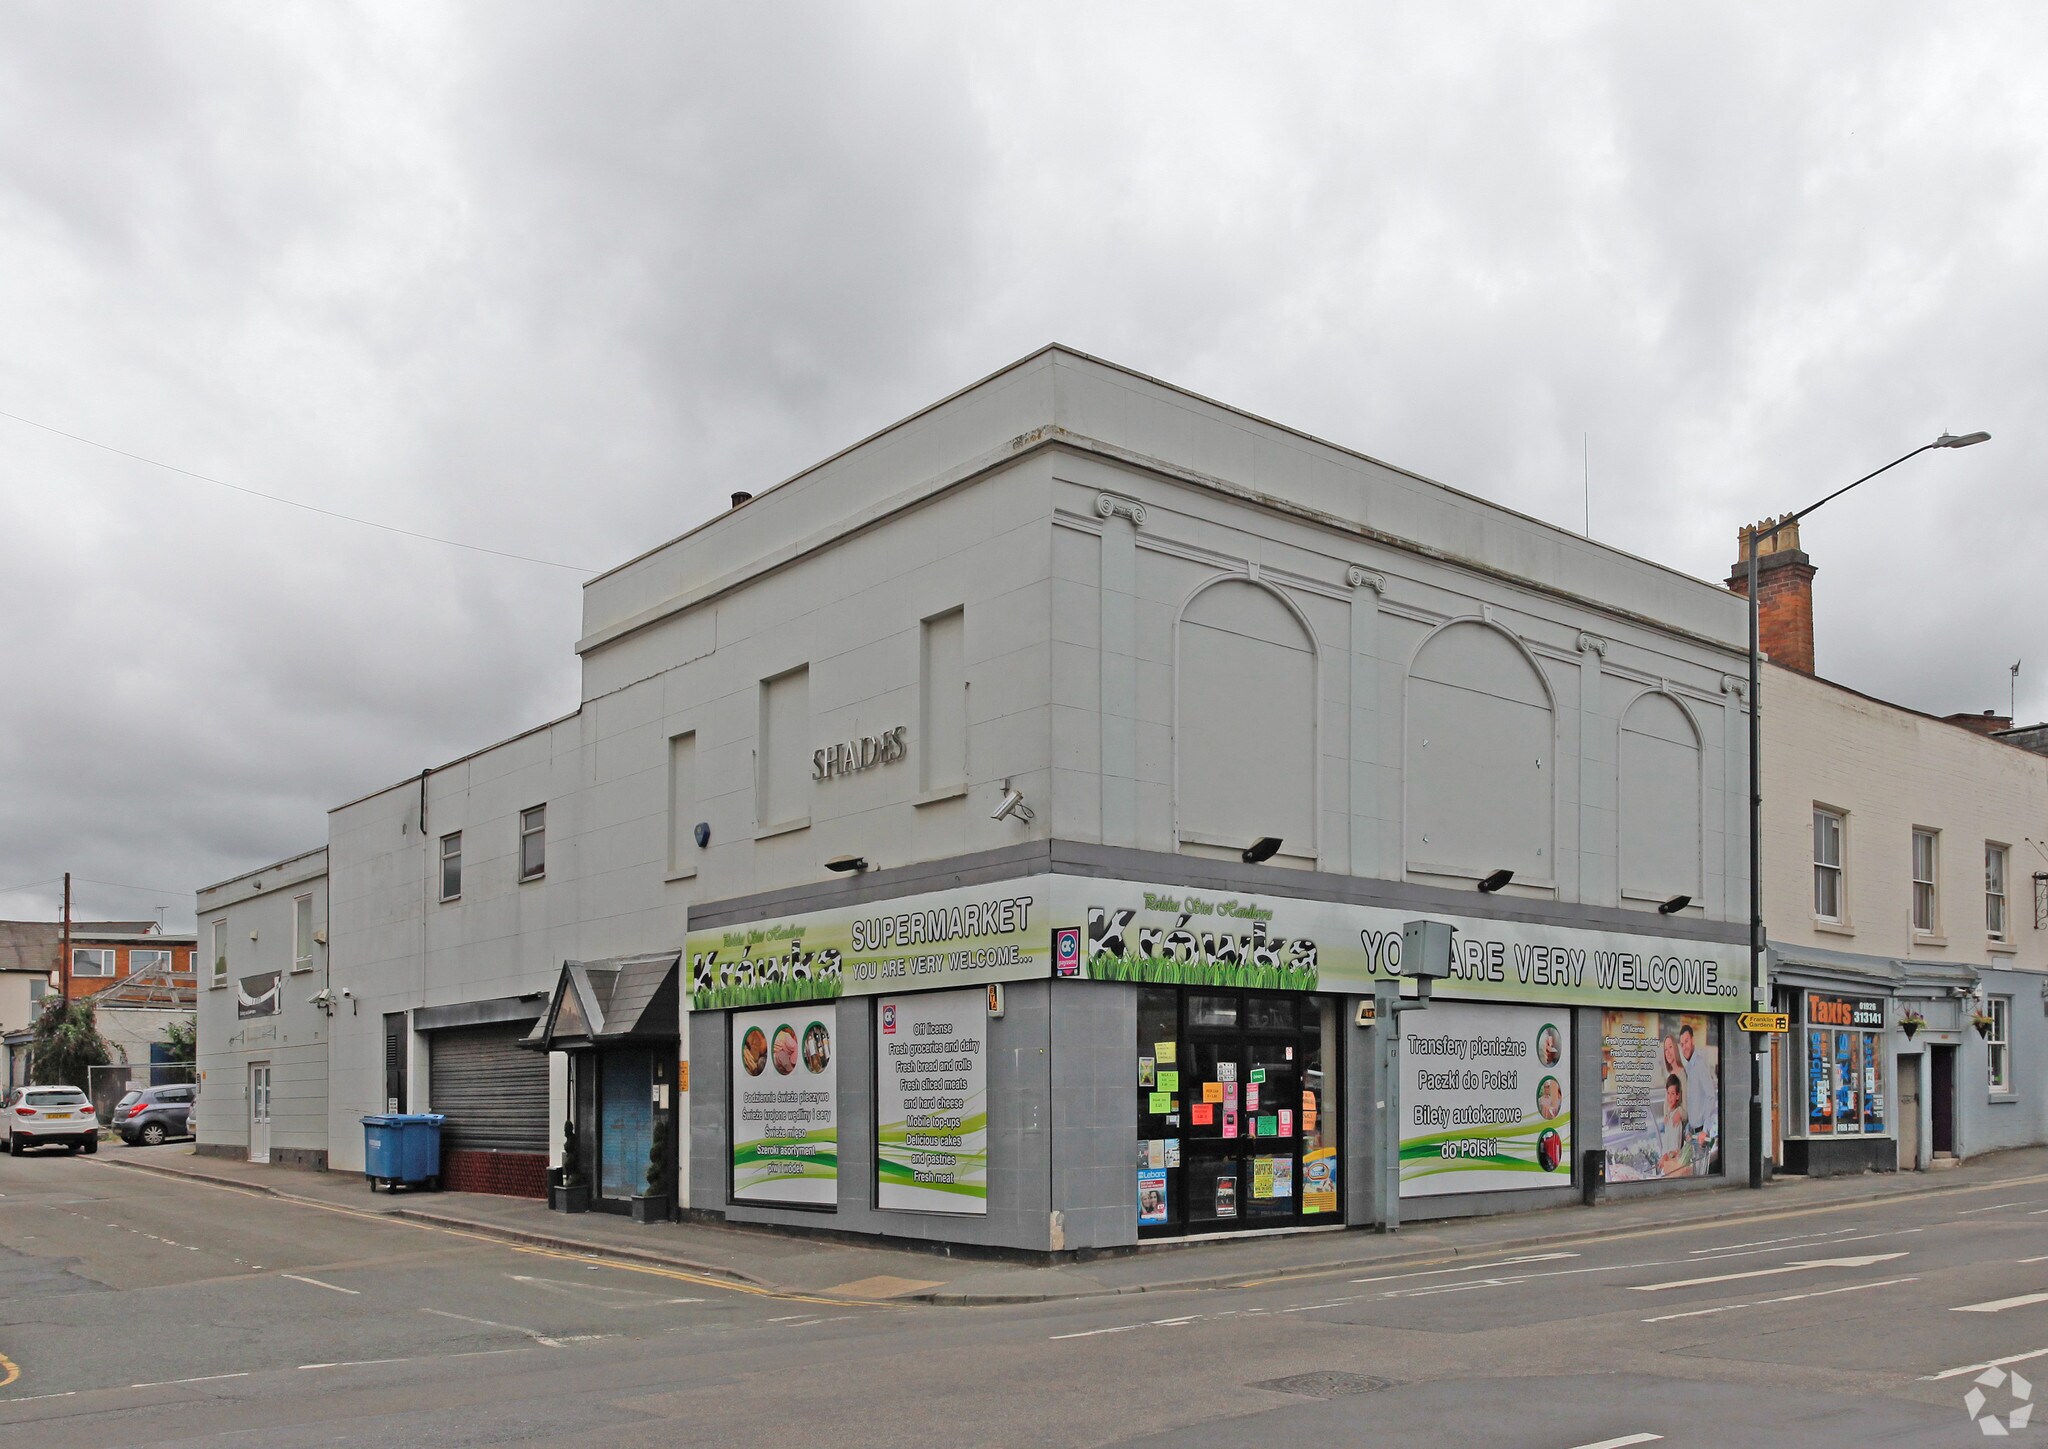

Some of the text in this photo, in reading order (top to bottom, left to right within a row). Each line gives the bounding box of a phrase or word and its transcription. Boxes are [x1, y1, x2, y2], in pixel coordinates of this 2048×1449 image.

[811, 725, 907, 780] SHADES
[852, 896, 1033, 952] SUPERMARKET
[1088, 907, 1318, 979] Krówka
[694, 939, 843, 995] Krówka
[852, 945, 1032, 981] YOU ARE VERY WELCOME...
[1361, 929, 1403, 976] YO
[1513, 943, 1586, 987] VERY
[1594, 950, 1738, 997] WELCOME...
[1809, 995, 1852, 1025] Taxis
[1859, 1002, 1877, 1011] 01926
[1854, 1011, 1882, 1024] 313141
[913, 1022, 953, 1036] Off license
[888, 1038, 980, 1057] Fresh groceries and dairy
[1407, 1034, 1467, 1060] Transfery
[896, 1058, 972, 1073] Fresh bread and rolls
[900, 1078, 968, 1091] Fresh sliced meats
[1418, 1070, 1518, 1091] Paczki do Polski
[800, 1090, 829, 1105] pieczywo
[904, 1097, 964, 1109] and hard cheese
[816, 1109, 831, 1122] sery
[906, 1115, 961, 1130] Mobile top-ups
[1414, 1104, 1522, 1129] Bilety autokarowe
[906, 1133, 962, 1146] Delicious cakes
[757, 1143, 816, 1157] Szeroki asortyment
[1441, 1137, 1498, 1159] do Polski
[911, 1152, 956, 1167] and pastries
[913, 1170, 954, 1184] Fresh meat
[1144, 1171, 1166, 1179] Lebara
